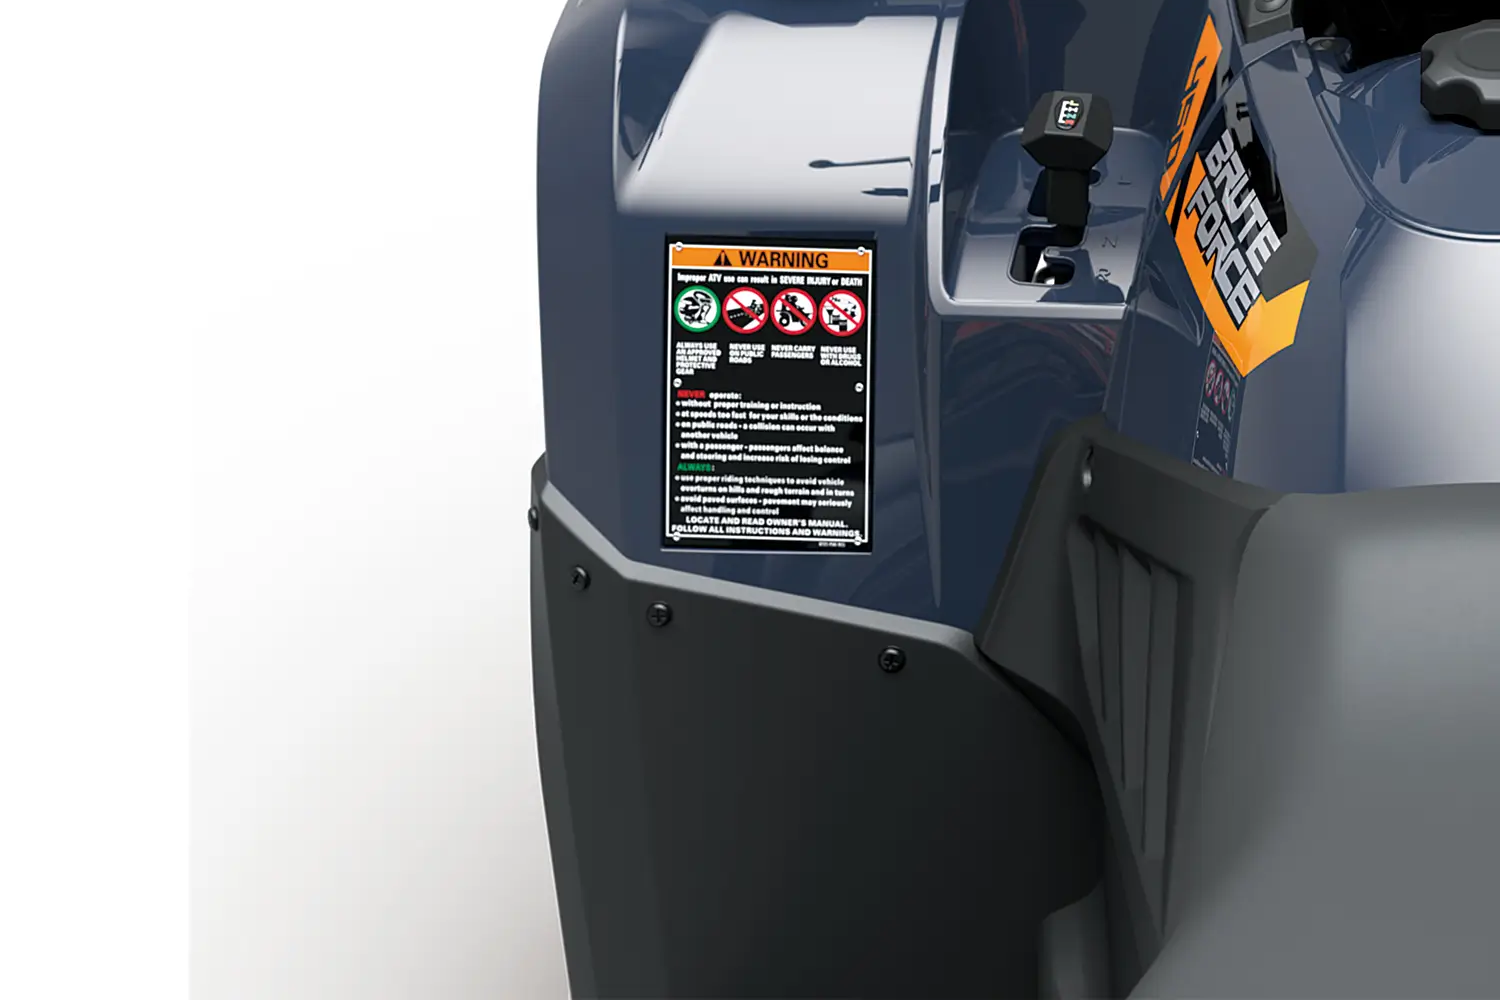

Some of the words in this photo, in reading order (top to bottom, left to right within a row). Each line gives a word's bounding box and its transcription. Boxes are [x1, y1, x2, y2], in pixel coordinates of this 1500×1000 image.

[1206, 130, 1281, 273] BRUTE
[1102, 236, 1118, 248] N
[739, 251, 828, 268] WARNING
[1187, 181, 1260, 324] FORCE
[1096, 269, 1111, 281] R
[685, 515, 720, 524] LOCATE
[720, 516, 740, 524] AND
[741, 517, 765, 525] READ
[766, 518, 806, 526] OWNER'S
[807, 519, 848, 528] MANUAL.
[671, 524, 707, 533] FOLLOW
[725, 526, 790, 535] INSTRUCTIONS
[812, 528, 863, 538] WARNINGS.
